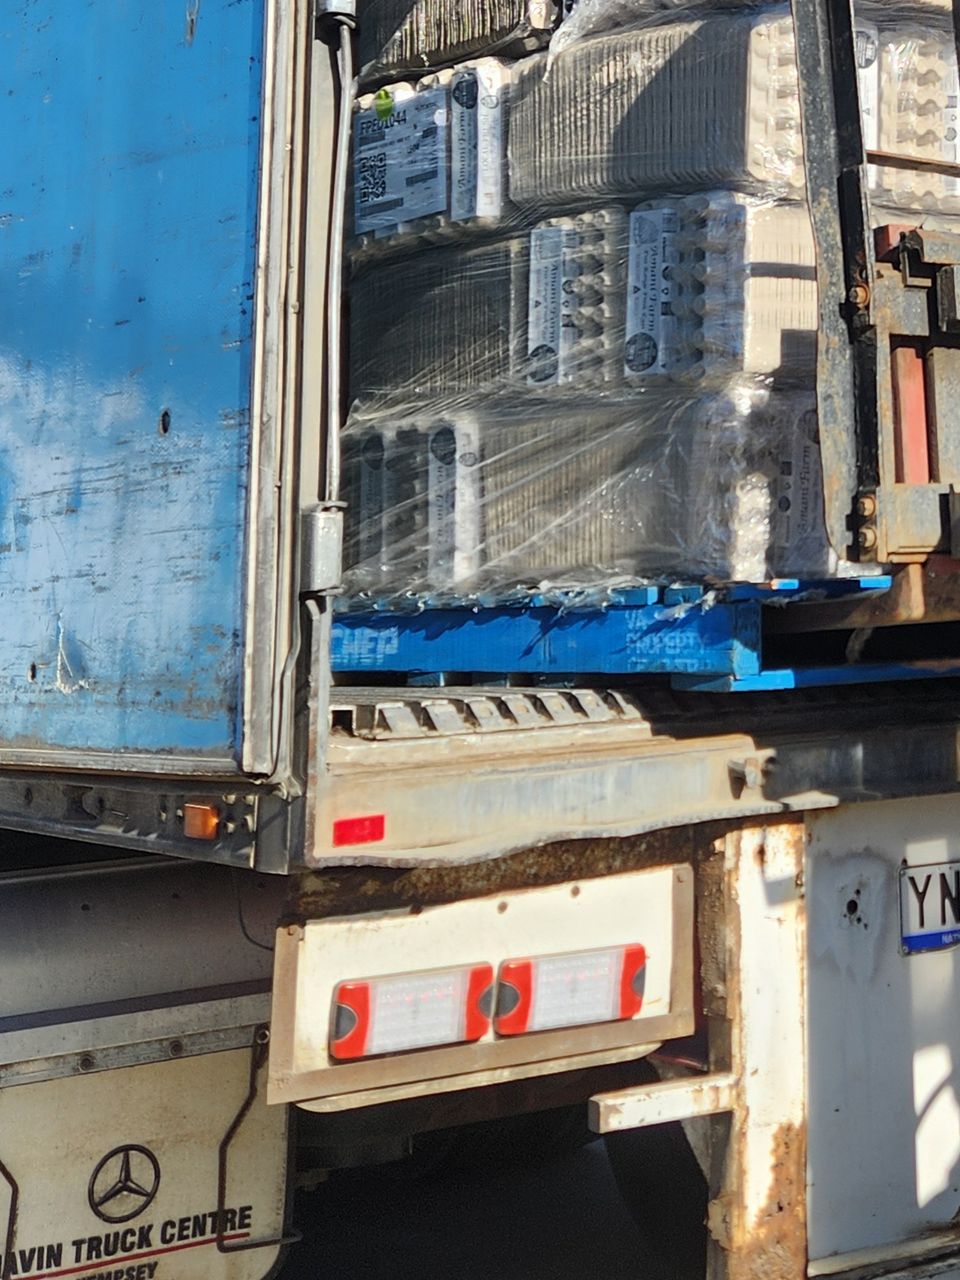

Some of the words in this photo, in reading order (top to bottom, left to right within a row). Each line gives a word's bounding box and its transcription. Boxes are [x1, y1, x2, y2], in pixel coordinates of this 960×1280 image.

[458, 112, 467, 144] Farm
[458, 149, 466, 189] Amani
[802, 446, 810, 483] Farm
[72, 1225, 152, 1264] TRUCK
[160, 1206, 252, 1245] CENTRE
